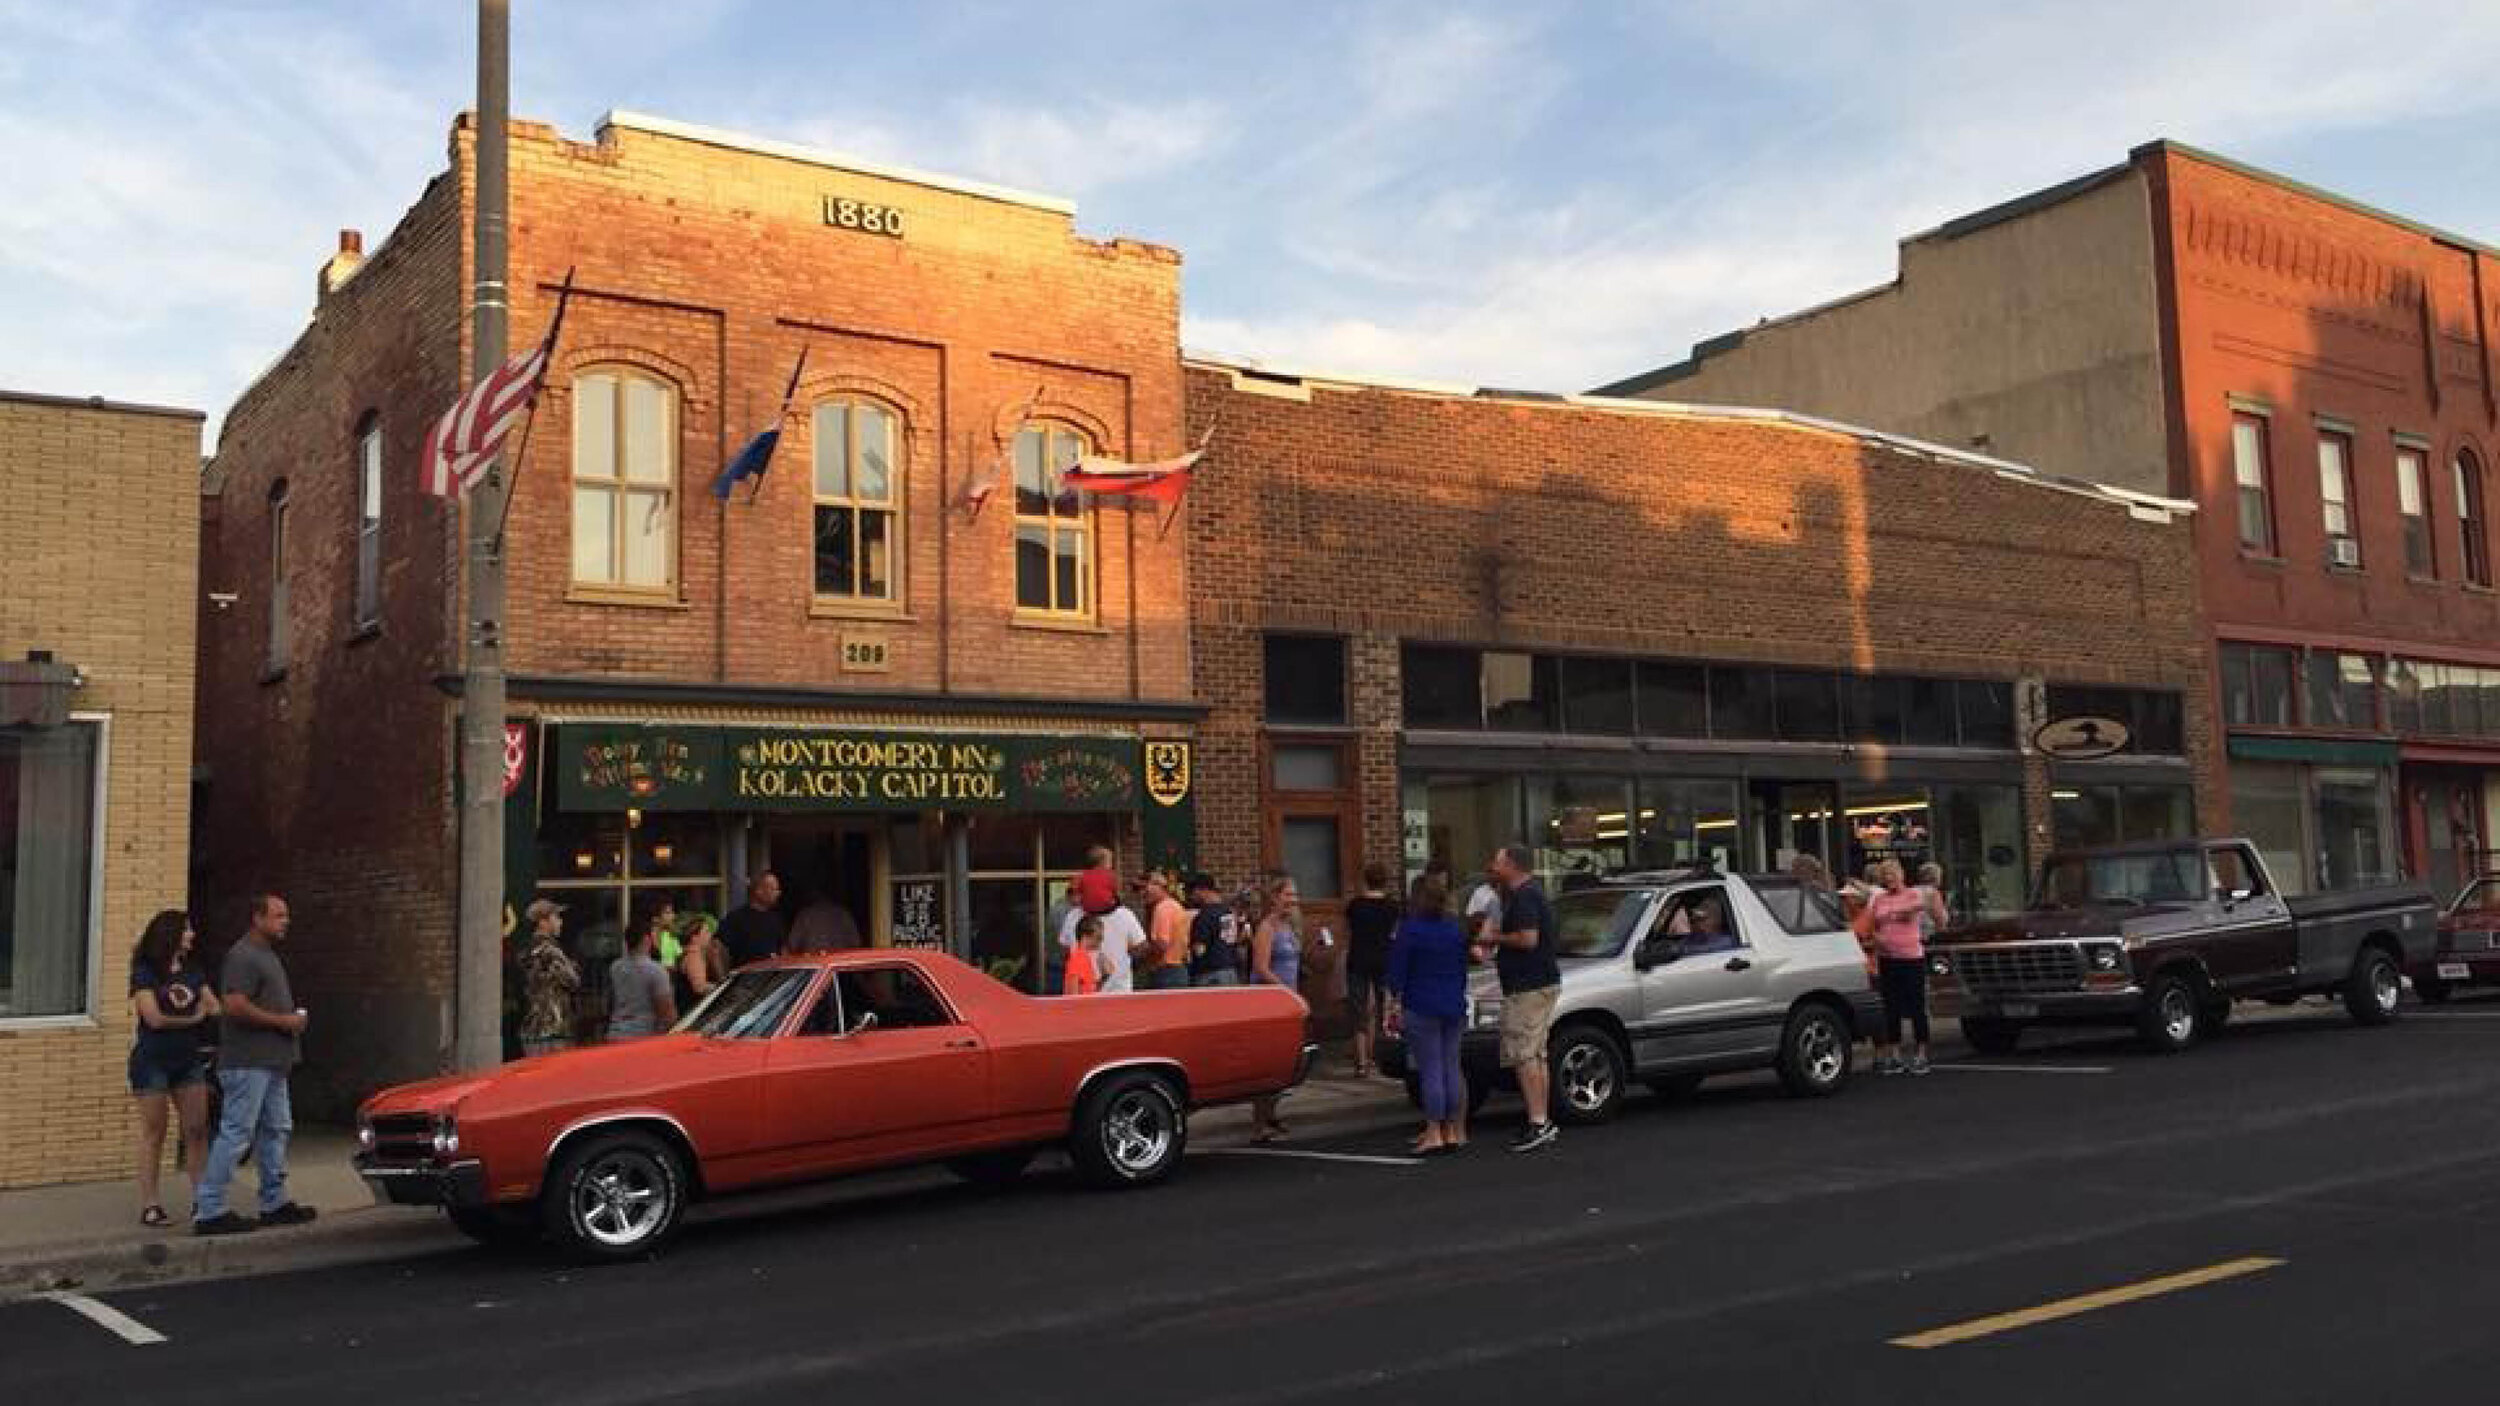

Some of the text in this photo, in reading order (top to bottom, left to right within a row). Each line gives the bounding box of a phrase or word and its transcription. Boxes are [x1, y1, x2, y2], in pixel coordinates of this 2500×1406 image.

[823, 195, 904, 237] 1880
[759, 739, 987, 769] MONTGOMERY MN
[739, 768, 873, 798] KOLACKY
[882, 772, 1006, 799] CAPITOL
